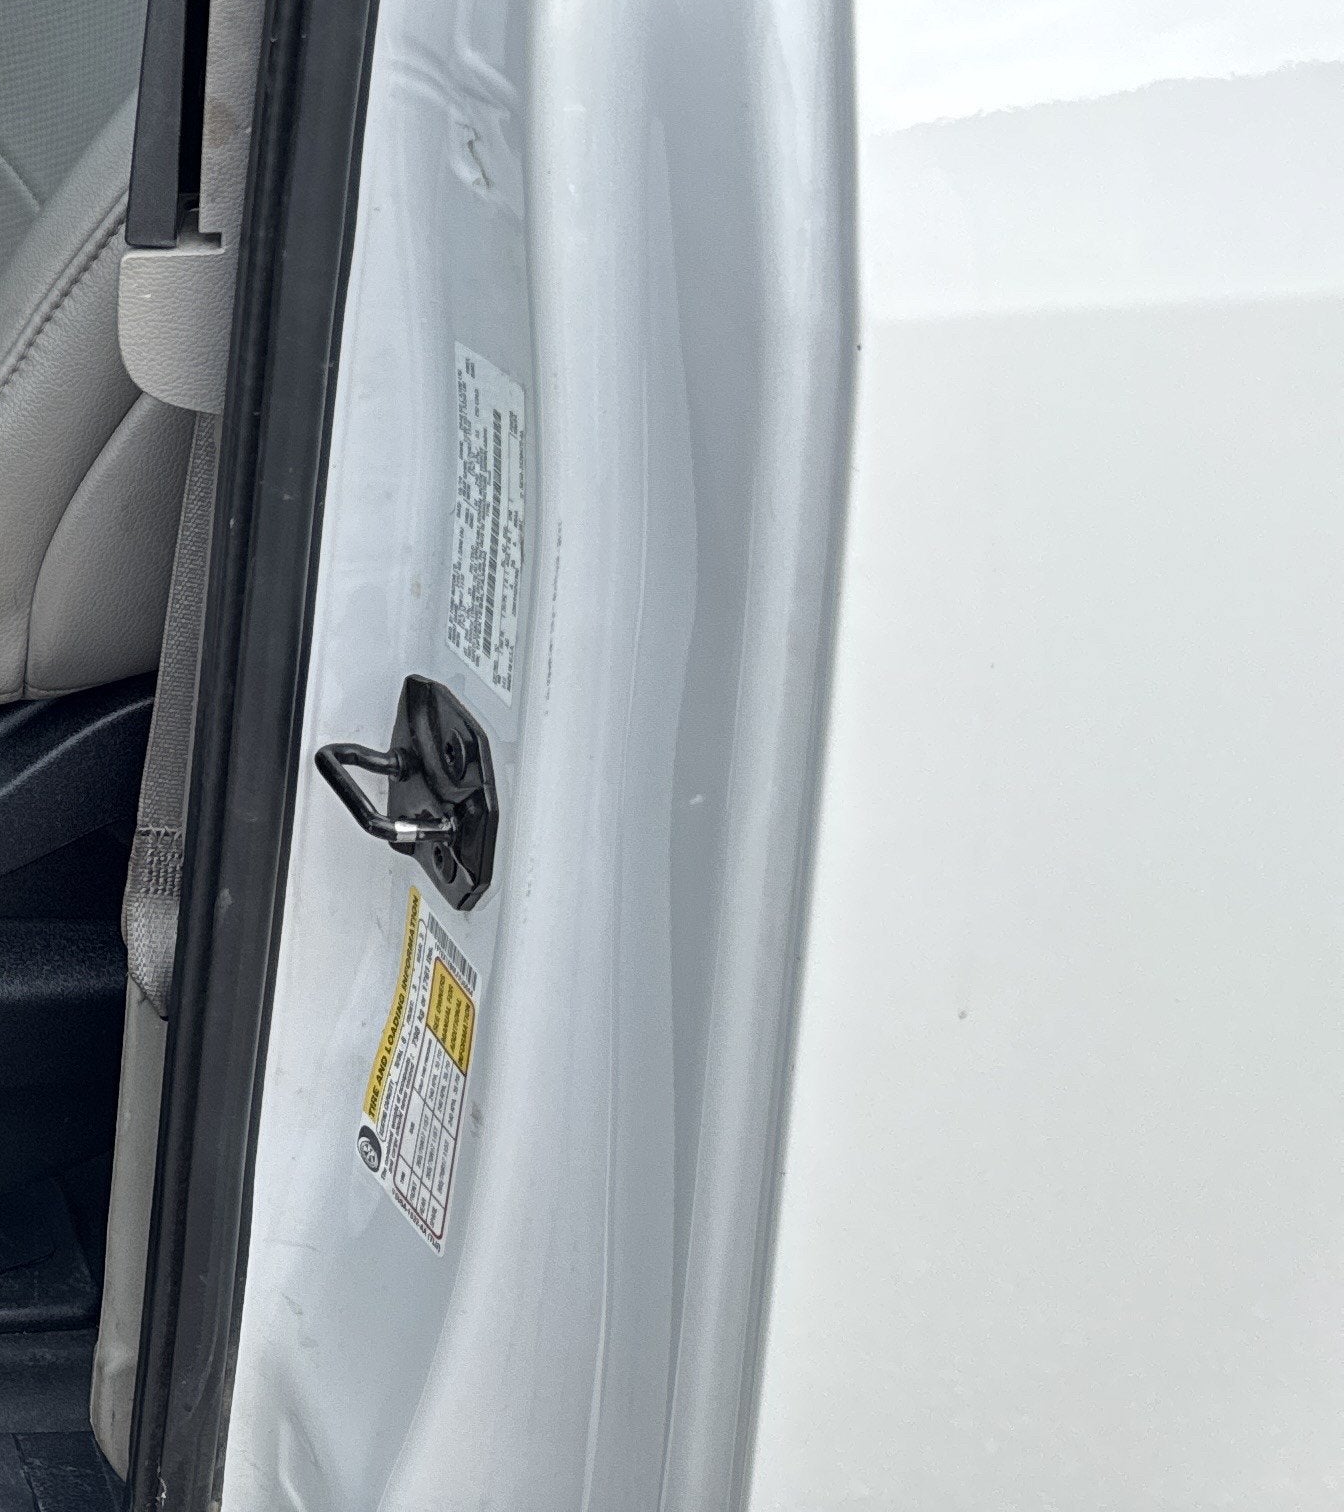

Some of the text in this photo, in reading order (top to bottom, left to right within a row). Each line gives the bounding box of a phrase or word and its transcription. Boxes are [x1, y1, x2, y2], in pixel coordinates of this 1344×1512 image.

[369, 897, 417, 1118] TIRE AND LOADING INFORMATION
